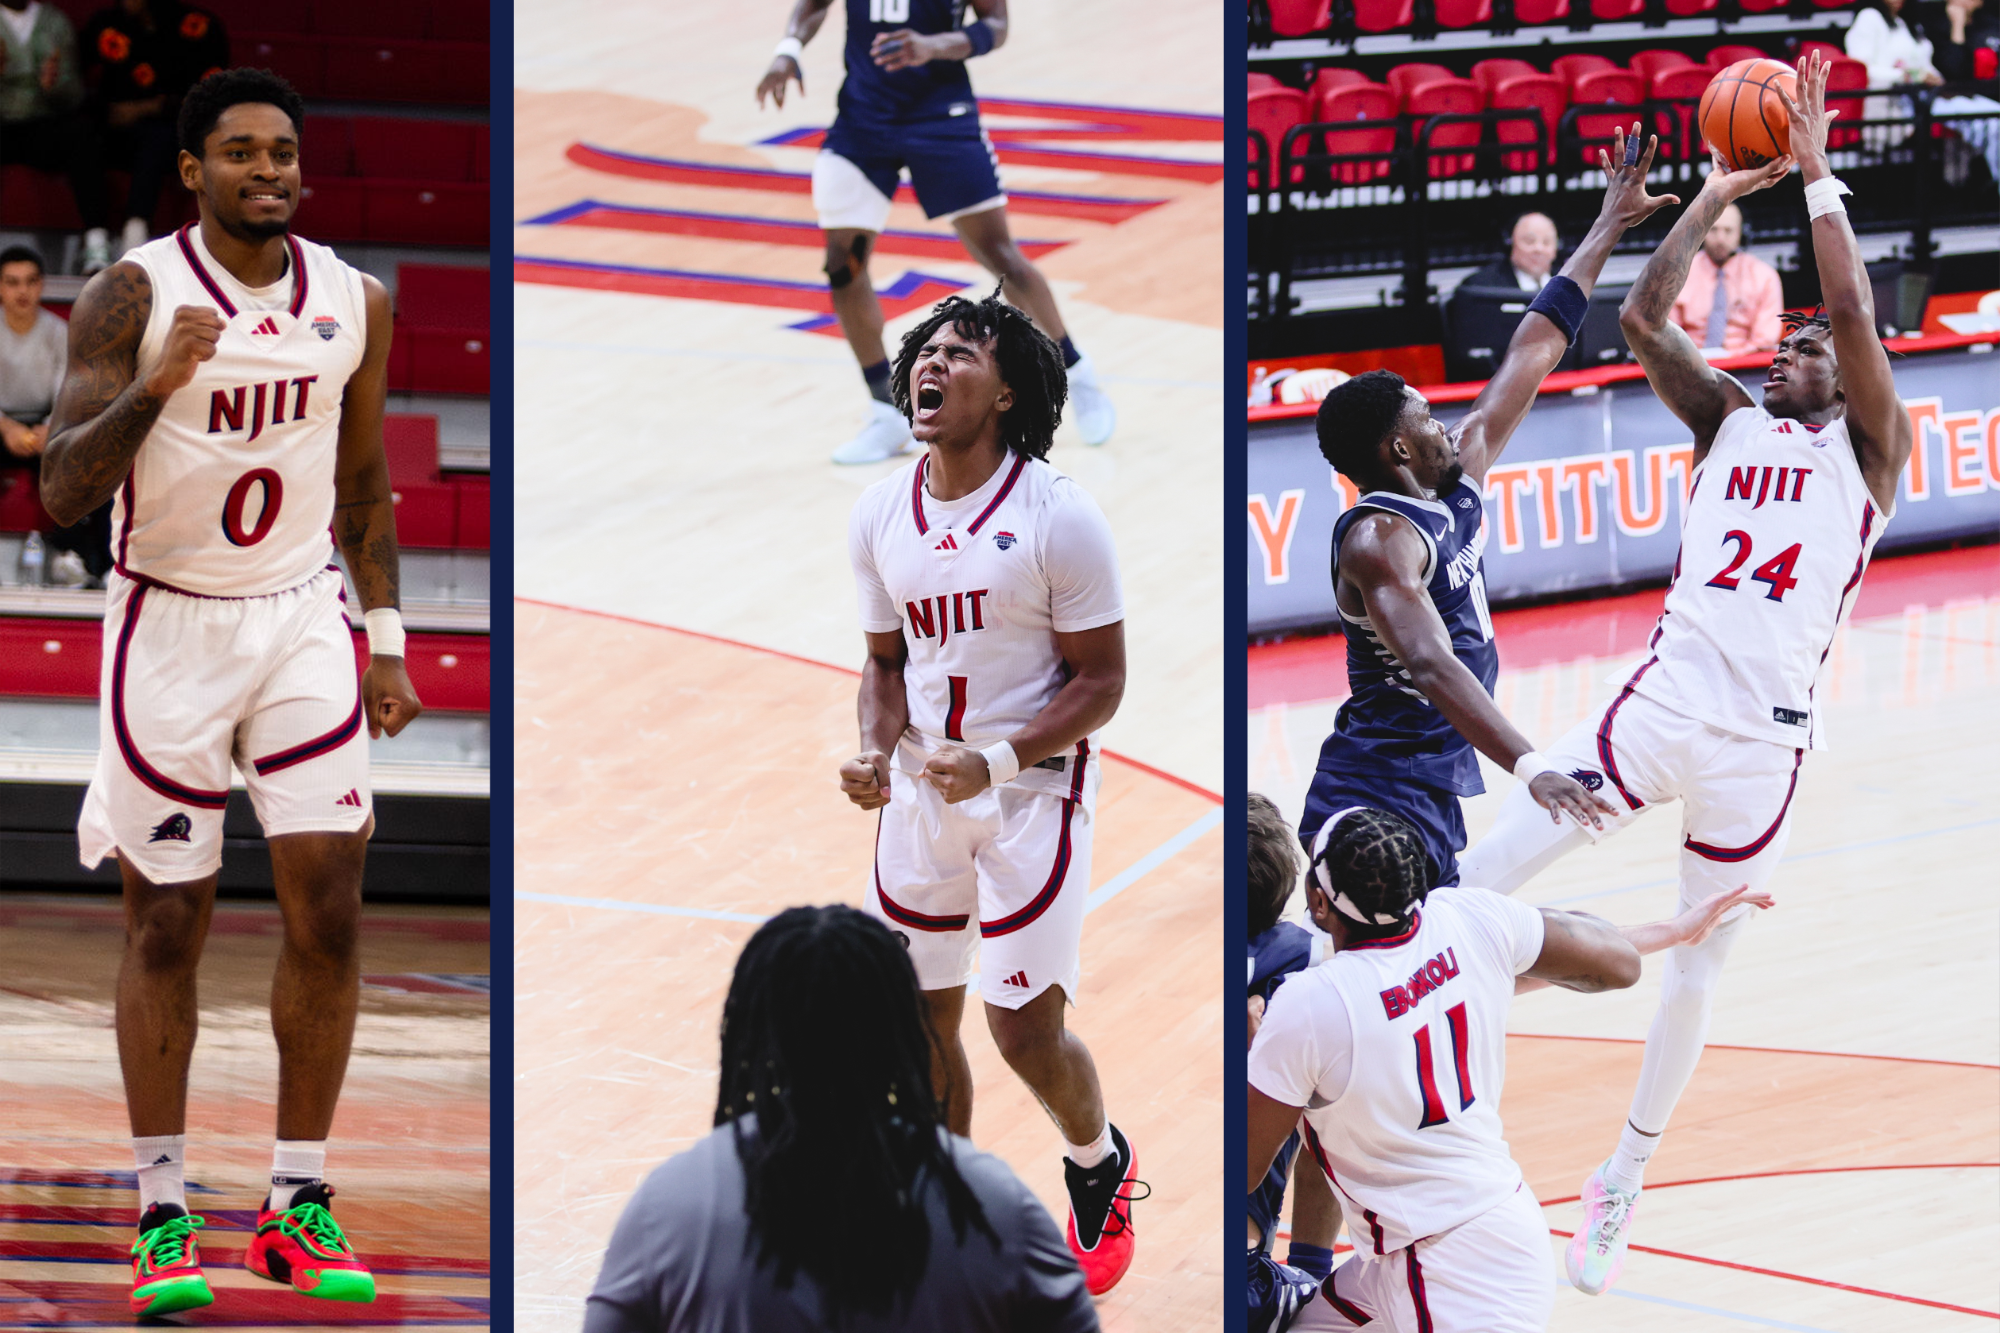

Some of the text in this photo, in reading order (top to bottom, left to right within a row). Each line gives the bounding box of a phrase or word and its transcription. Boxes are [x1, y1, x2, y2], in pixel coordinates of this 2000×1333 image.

[207, 375, 319, 443] NJIT
[221, 467, 284, 547] 0
[1724, 465, 1814, 511] NJIT
[992, 534, 1018, 545] AMERICA
[1704, 529, 1804, 603] 24
[905, 588, 989, 648] NJIT
[1468, 570, 1495, 644] 10
[944, 675, 969, 742] 1
[1412, 1000, 1476, 1130] 11
